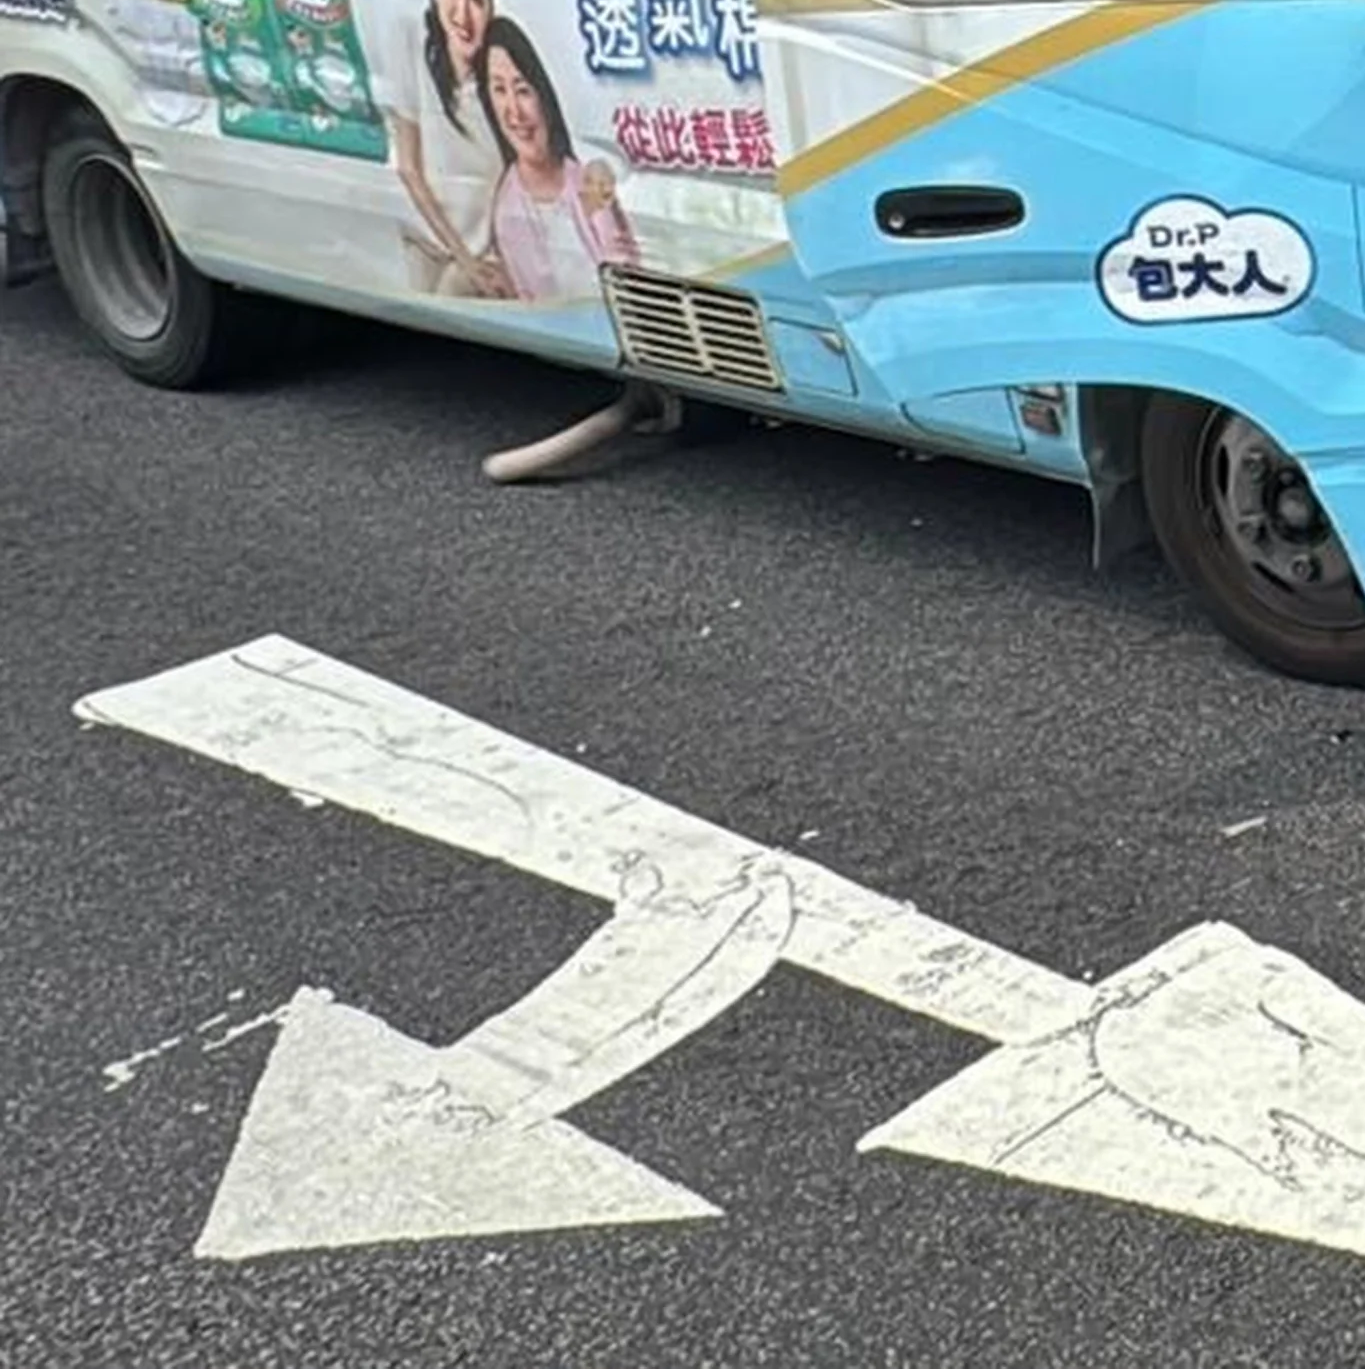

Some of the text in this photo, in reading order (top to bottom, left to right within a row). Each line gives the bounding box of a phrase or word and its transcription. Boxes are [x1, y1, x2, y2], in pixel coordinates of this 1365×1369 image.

[613, 106, 776, 170] 從此輕鬆
[1147, 222, 1220, 248] Dr.P
[1128, 250, 1286, 300] 包大人
